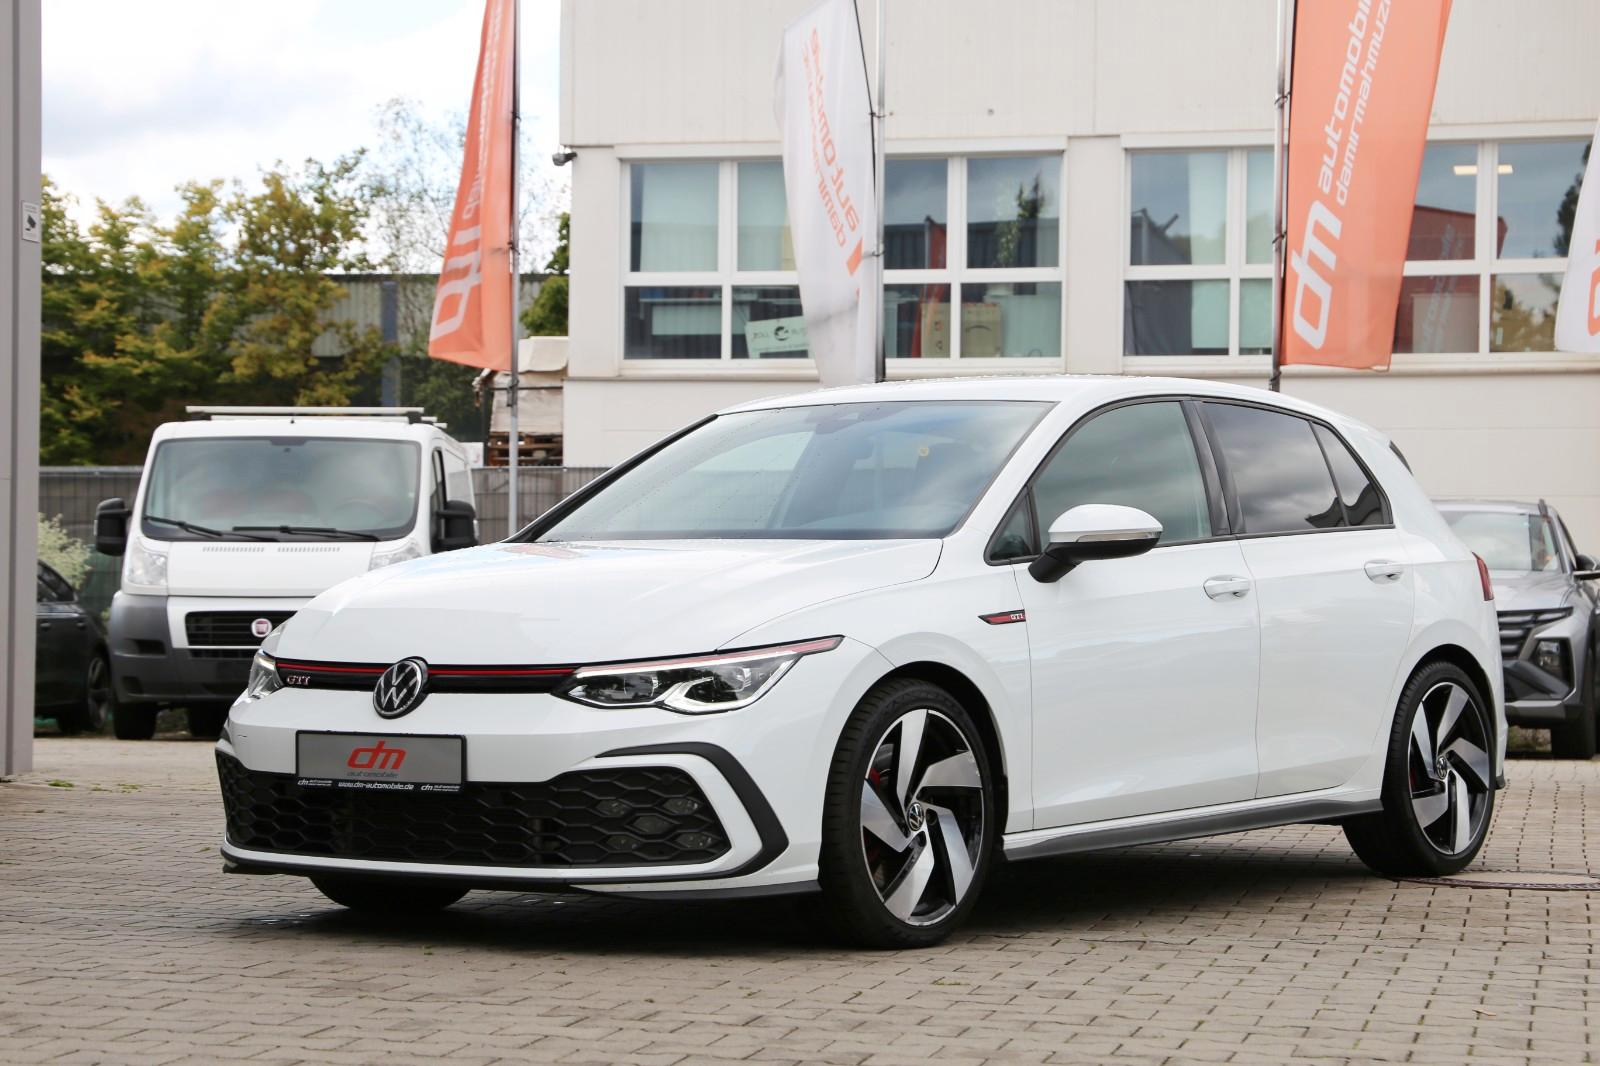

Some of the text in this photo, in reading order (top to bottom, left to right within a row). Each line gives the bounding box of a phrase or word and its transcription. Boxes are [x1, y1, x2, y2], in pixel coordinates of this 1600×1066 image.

[1291, 200, 1343, 350] dm
[286, 675, 311, 685] GTI
[347, 740, 407, 769] dm
[338, 781, 415, 791] www.dm-automobile.de
